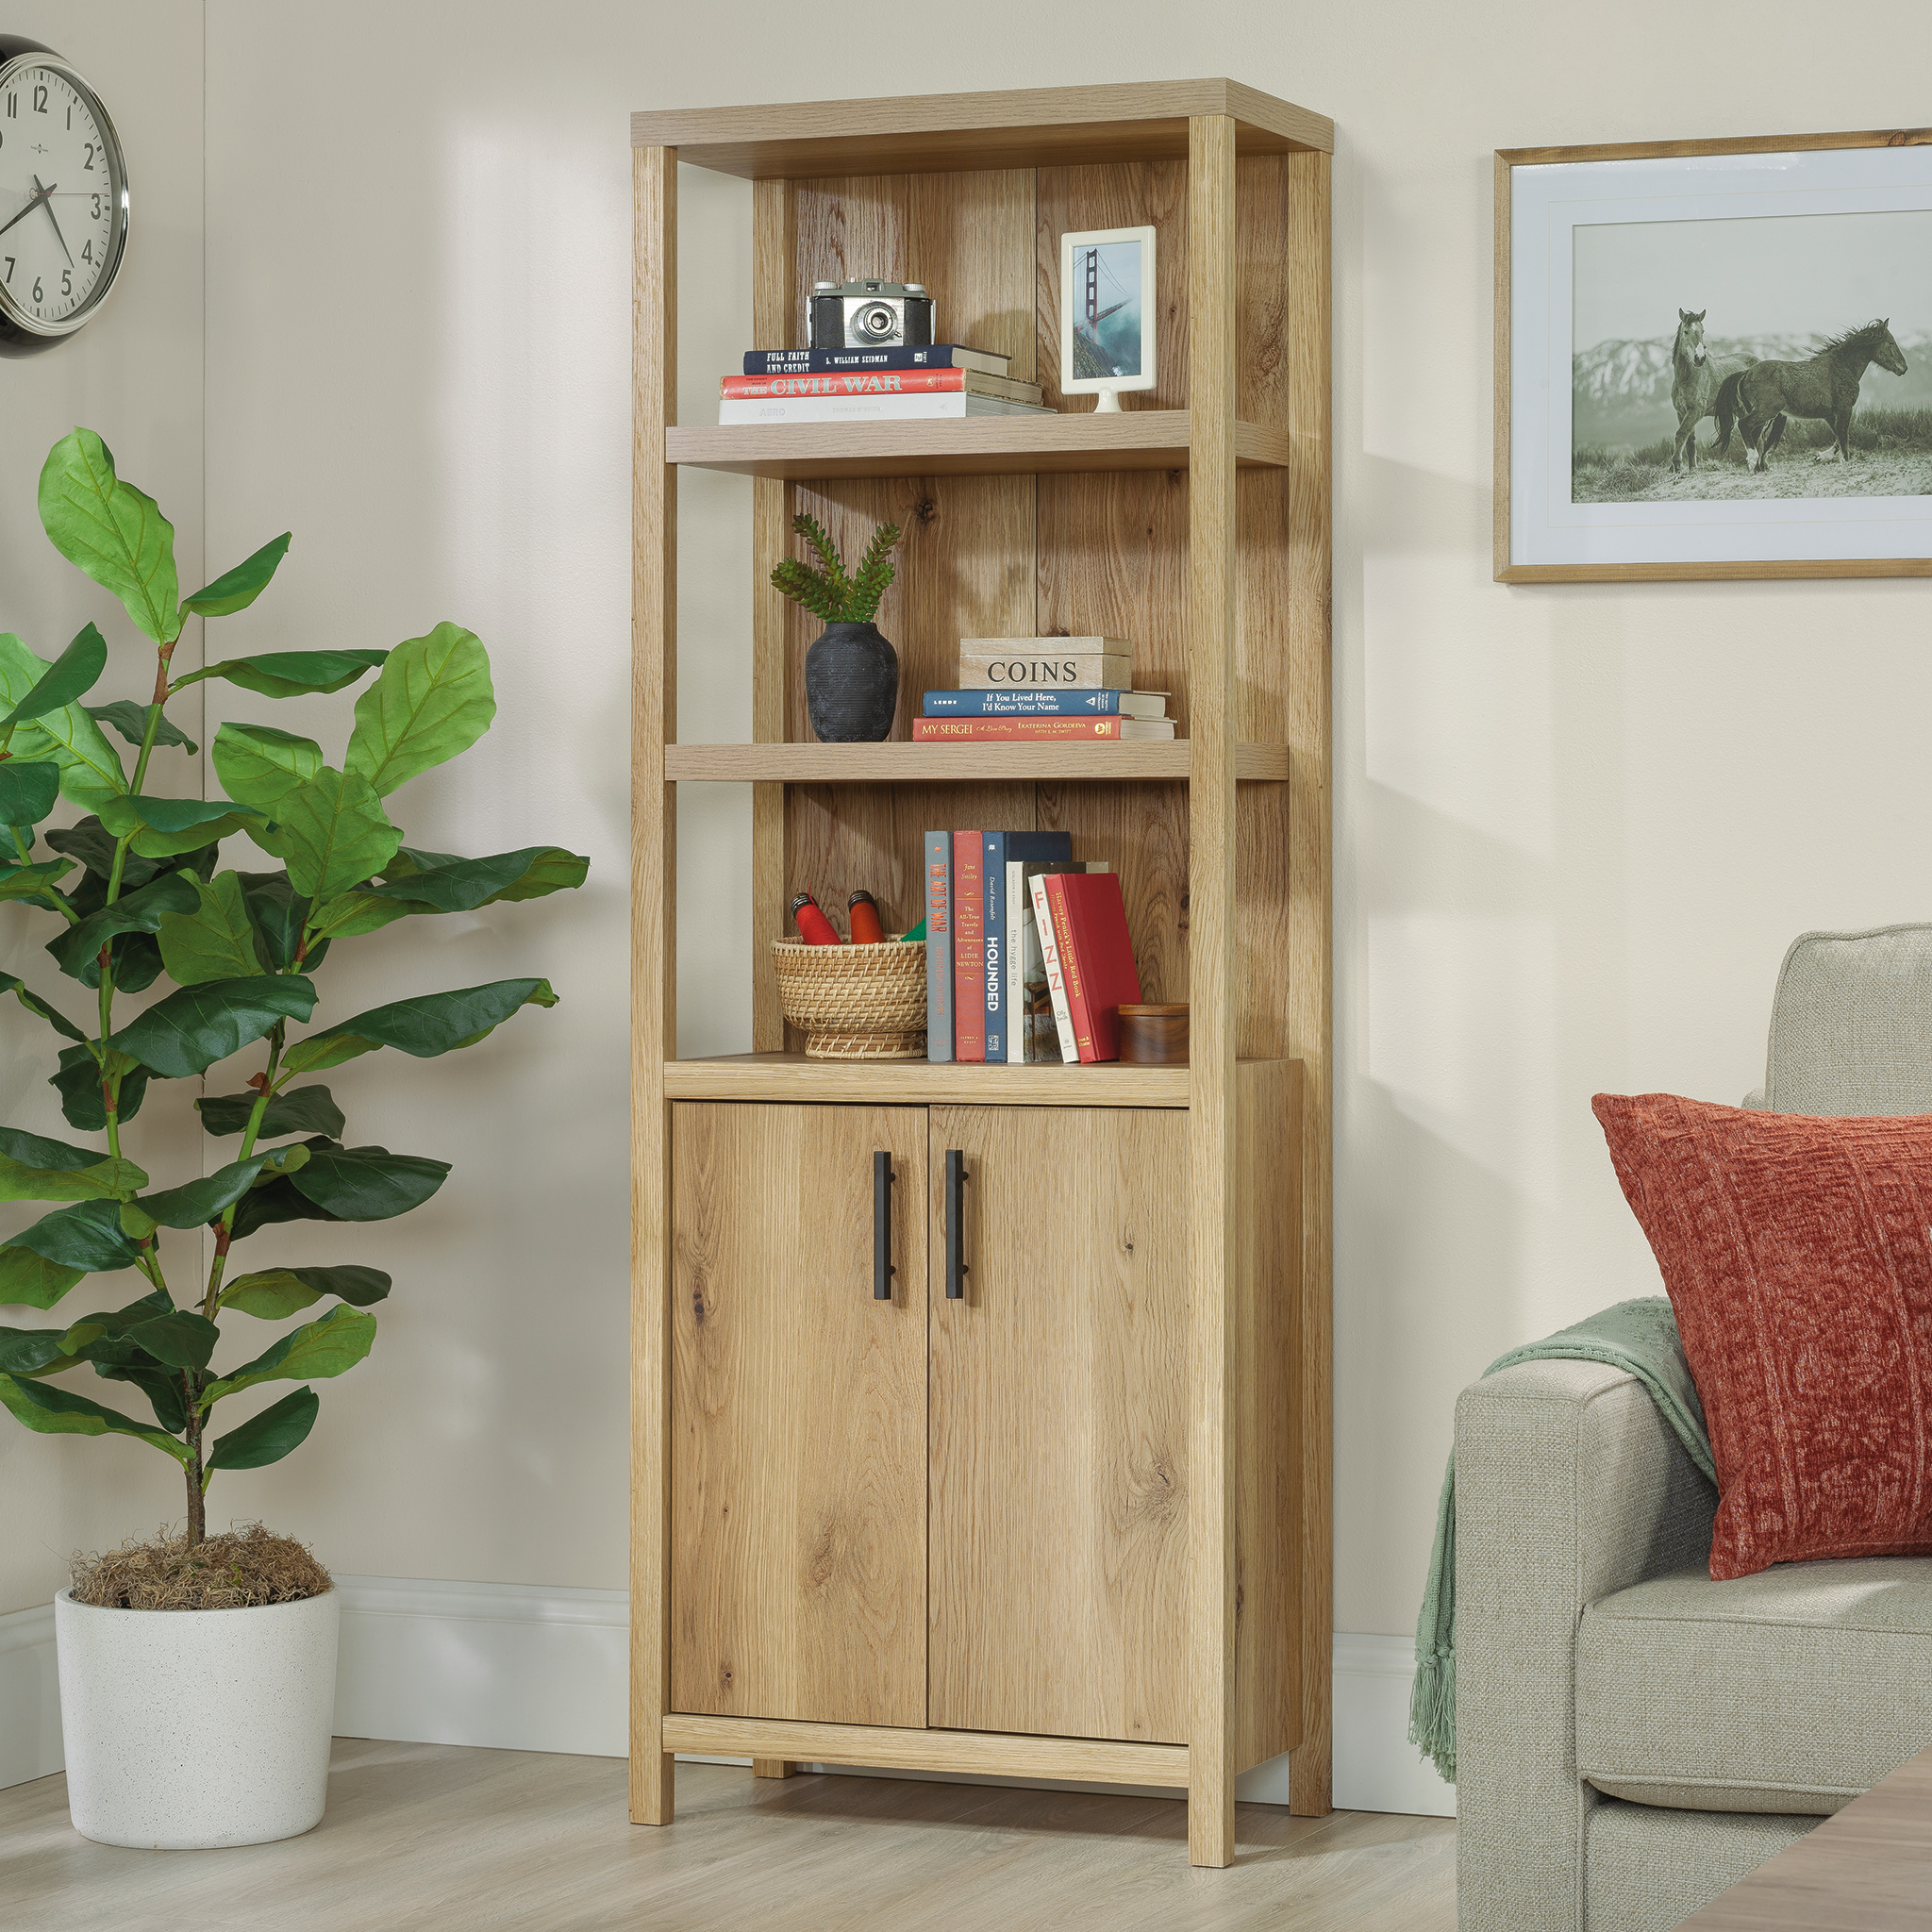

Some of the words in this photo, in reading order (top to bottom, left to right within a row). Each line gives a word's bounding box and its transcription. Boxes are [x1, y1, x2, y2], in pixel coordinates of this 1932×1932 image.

[7, 92, 17, 119] 11
[33, 85, 48, 114] 12
[66, 105, 71, 130] 1
[84, 142, 94, 171] 2
[91, 192, 101, 220] 3
[81, 239, 92, 265] 4
[5, 256, 16, 283] 7
[32, 276, 43, 303] 6
[60, 269, 72, 296] 5
[766, 353, 785, 361] FULL
[788, 351, 810, 361] FAITH
[834, 356, 859, 364] WILLIAM
[861, 355, 888, 363] SEIDMAN
[766, 364, 782, 374] AND
[783, 363, 810, 373] CREDIT
[742, 387, 767, 395] THE
[771, 377, 837, 395] CIVIL
[842, 375, 903, 392] WAR
[759, 408, 786, 417] AERO
[987, 661, 1077, 682] COINS
[982, 703, 992, 711] I'd
[994, 703, 1017, 711] Know
[1017, 703, 1036, 711] Your
[1037, 703, 1059, 711] Name
[986, 693, 994, 702] If
[996, 693, 1010, 702] You
[1011, 693, 1033, 702] Lived
[1035, 693, 1057, 702] Here,
[922, 724, 938, 735] MY
[940, 724, 973, 735] SERGEI
[929, 863, 946, 878] THE
[930, 881, 947, 897] ART
[930, 899, 947, 909] OF
[1056, 891, 1064, 915] Harvey
[930, 911, 947, 932] WAR
[1060, 916, 1071, 944] Penick's
[1009, 945, 1018, 970] hygge
[1065, 945, 1074, 964] Little
[987, 937, 999, 1011] HOUNDED
[1073, 979, 1081, 998] Book
[936, 984, 944, 1016] COONTS
